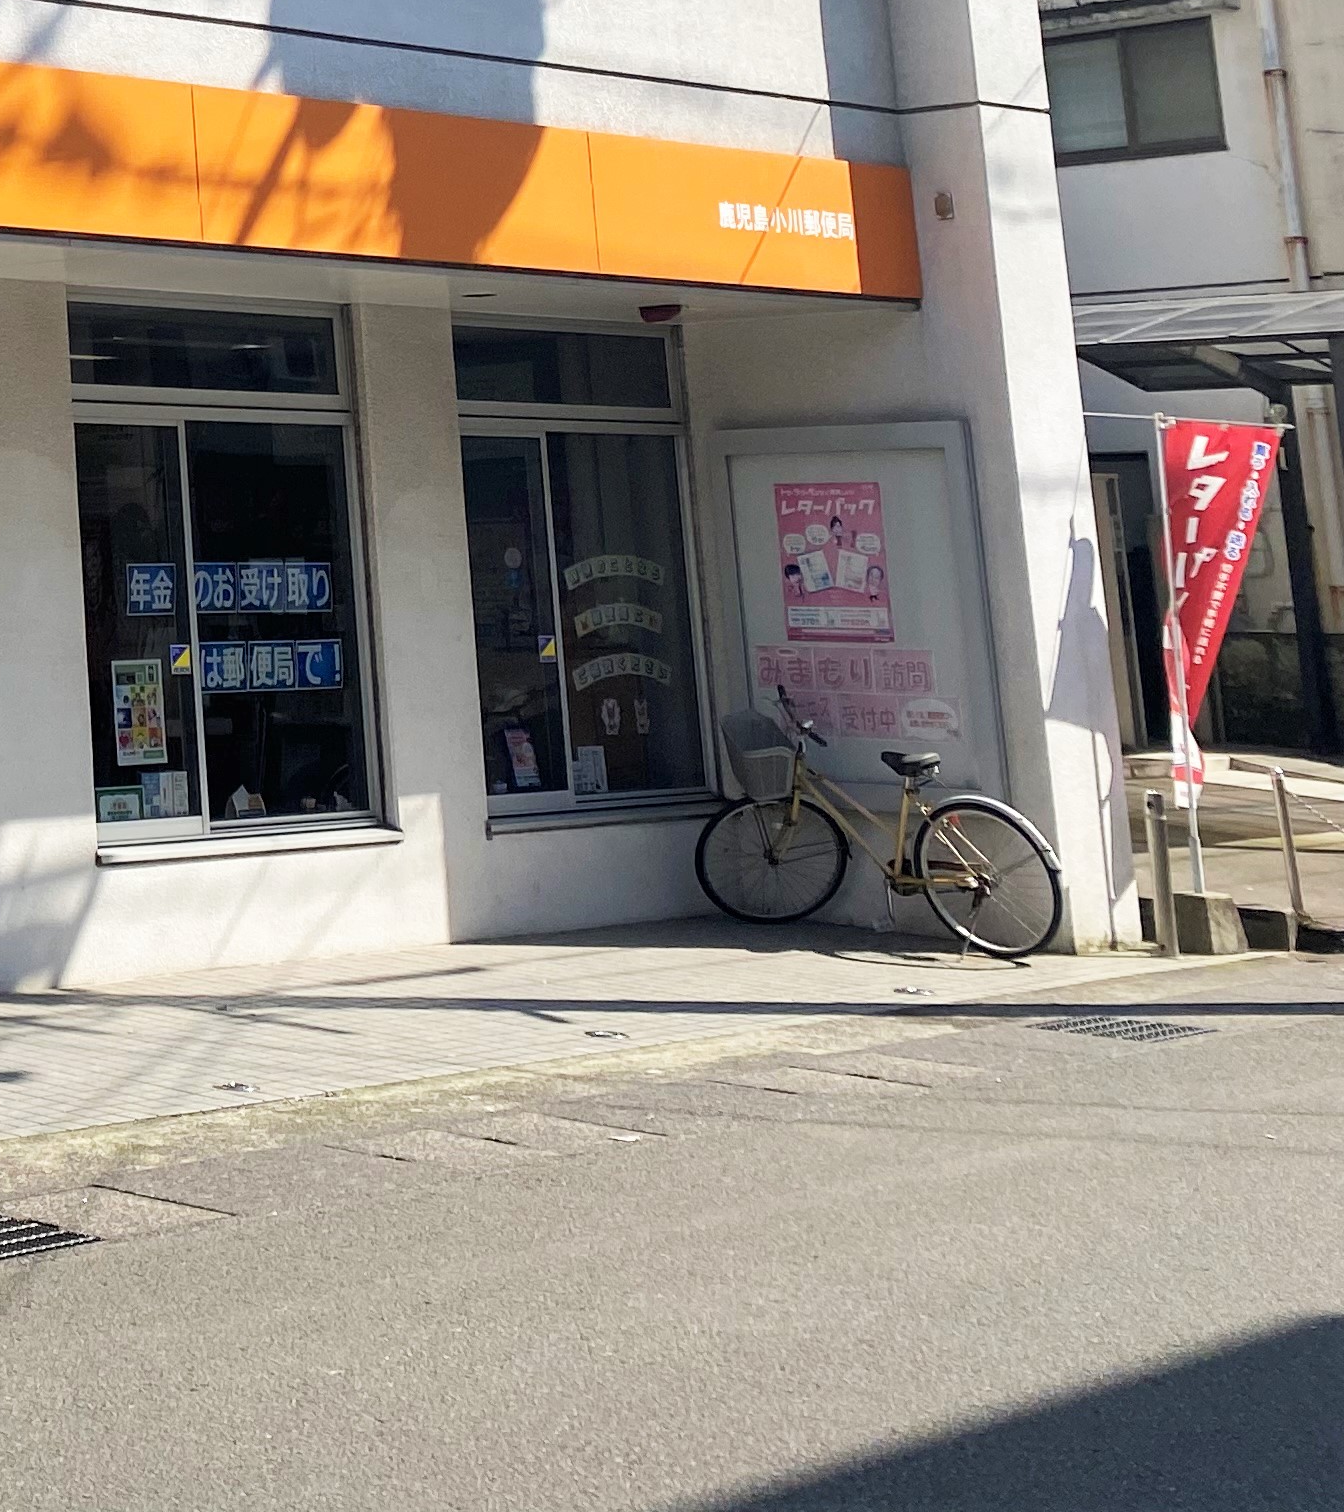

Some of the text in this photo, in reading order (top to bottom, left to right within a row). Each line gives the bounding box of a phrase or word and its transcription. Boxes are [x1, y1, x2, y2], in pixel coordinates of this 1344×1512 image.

[718, 201, 855, 241] 鹿児島小川郵便局
[781, 497, 876, 516] レターパック
[130, 567, 330, 611] 年金のお受け取り
